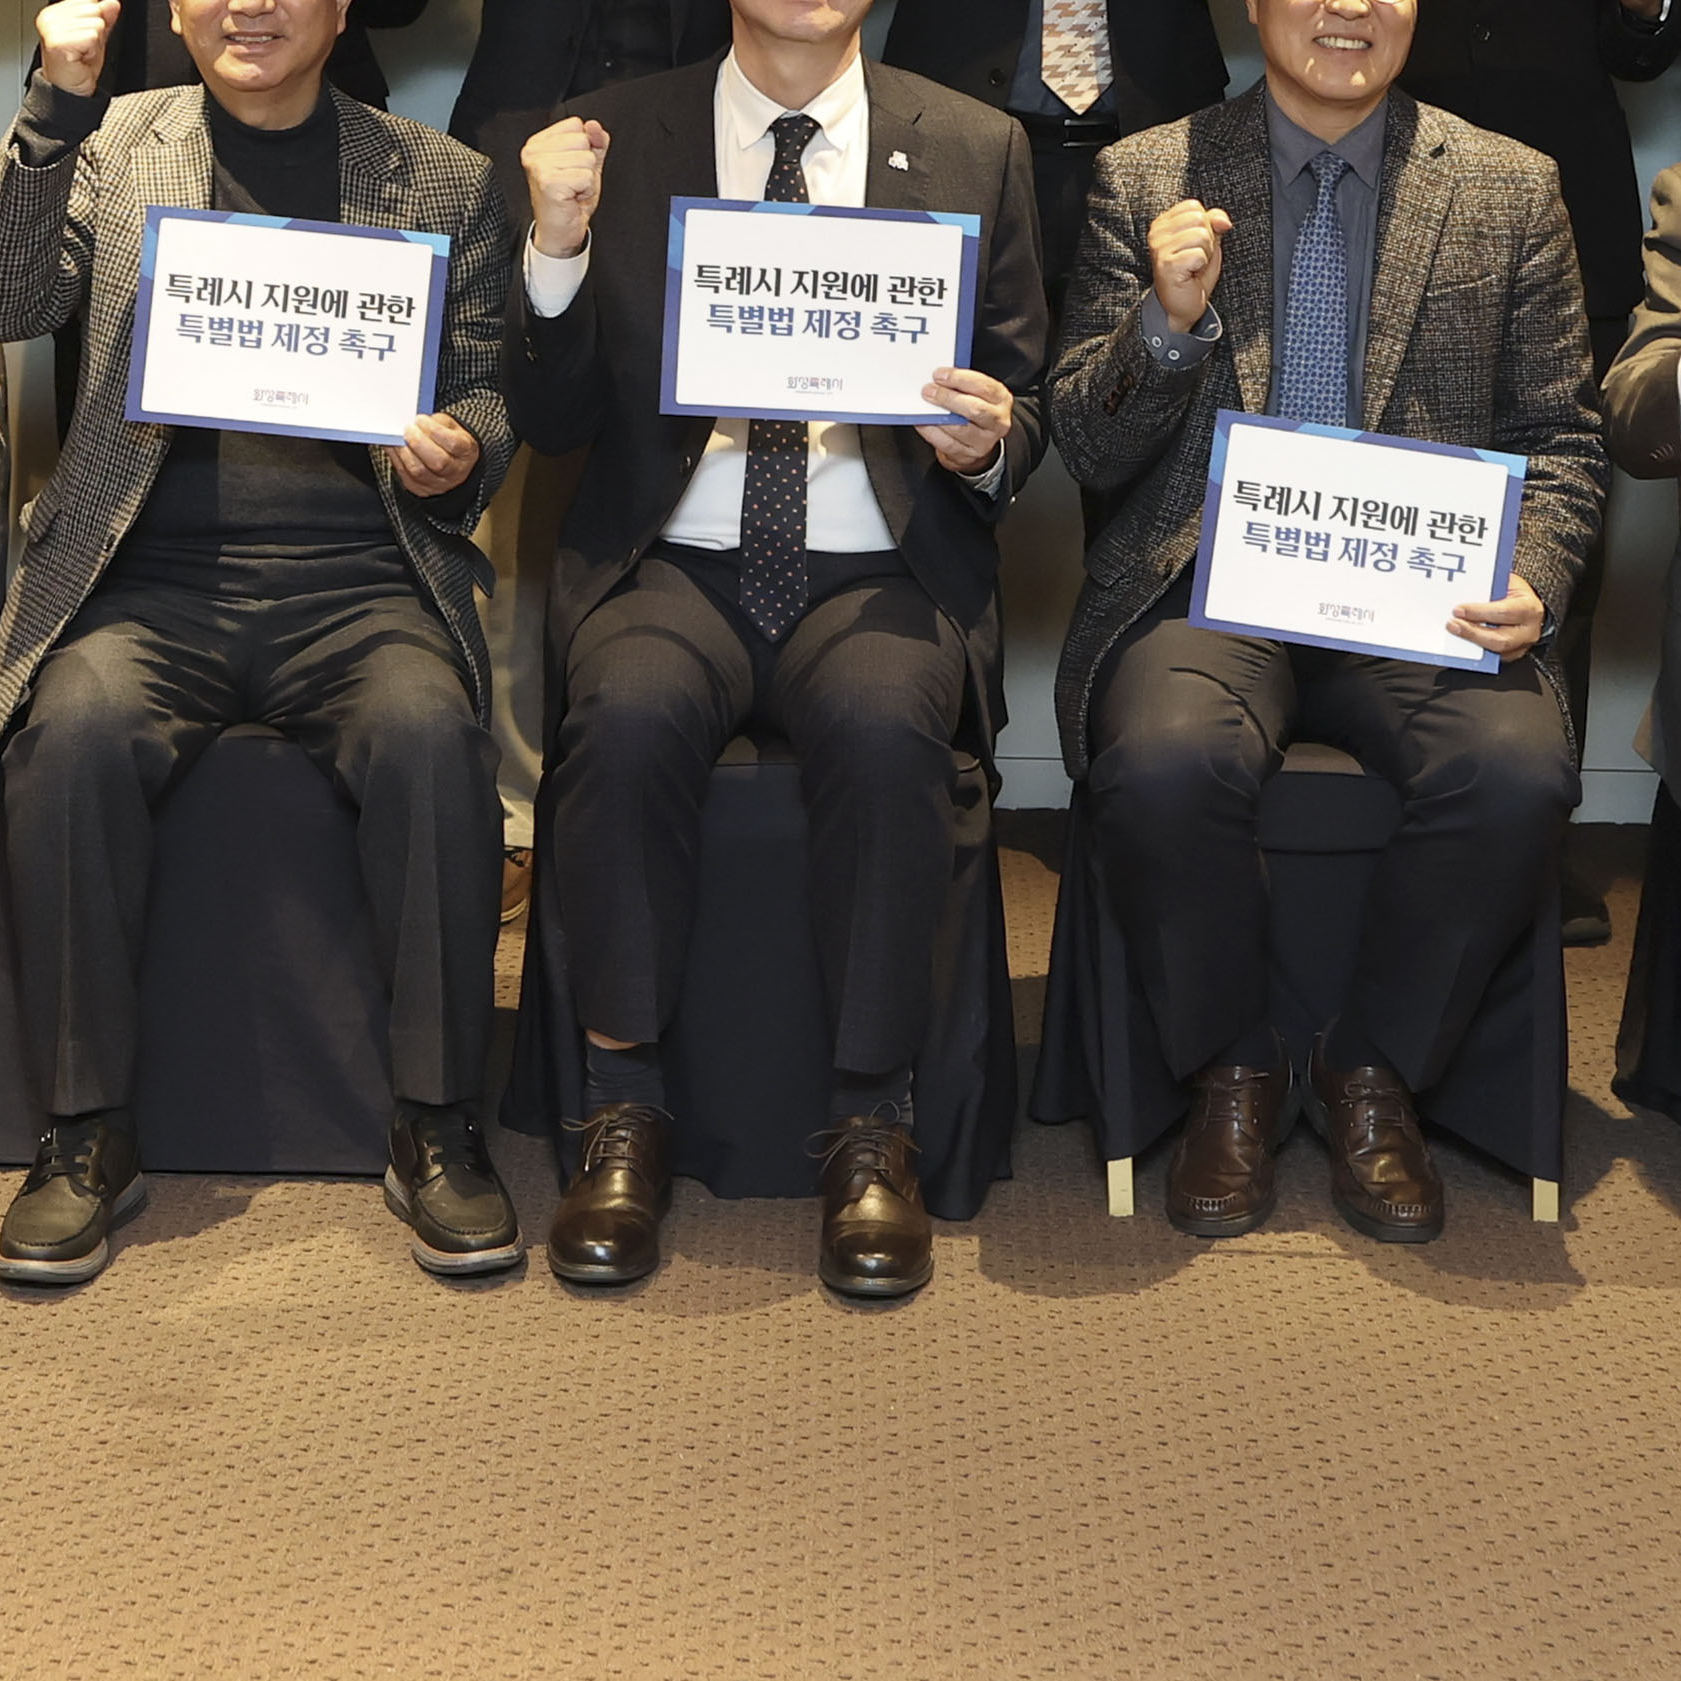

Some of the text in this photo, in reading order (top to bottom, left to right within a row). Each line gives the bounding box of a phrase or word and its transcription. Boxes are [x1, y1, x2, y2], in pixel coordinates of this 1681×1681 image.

[166, 274, 415, 325] 특례시 지원에 관한
[694, 265, 947, 307] 특례시 지원에 관한
[177, 314, 396, 361] 특별법 제정 촉구
[707, 304, 929, 344] 특별법 제정 촉구
[1234, 480, 1488, 546] 특례시 지원에 관한
[1243, 521, 1466, 582] 특별법 제정 촉구
